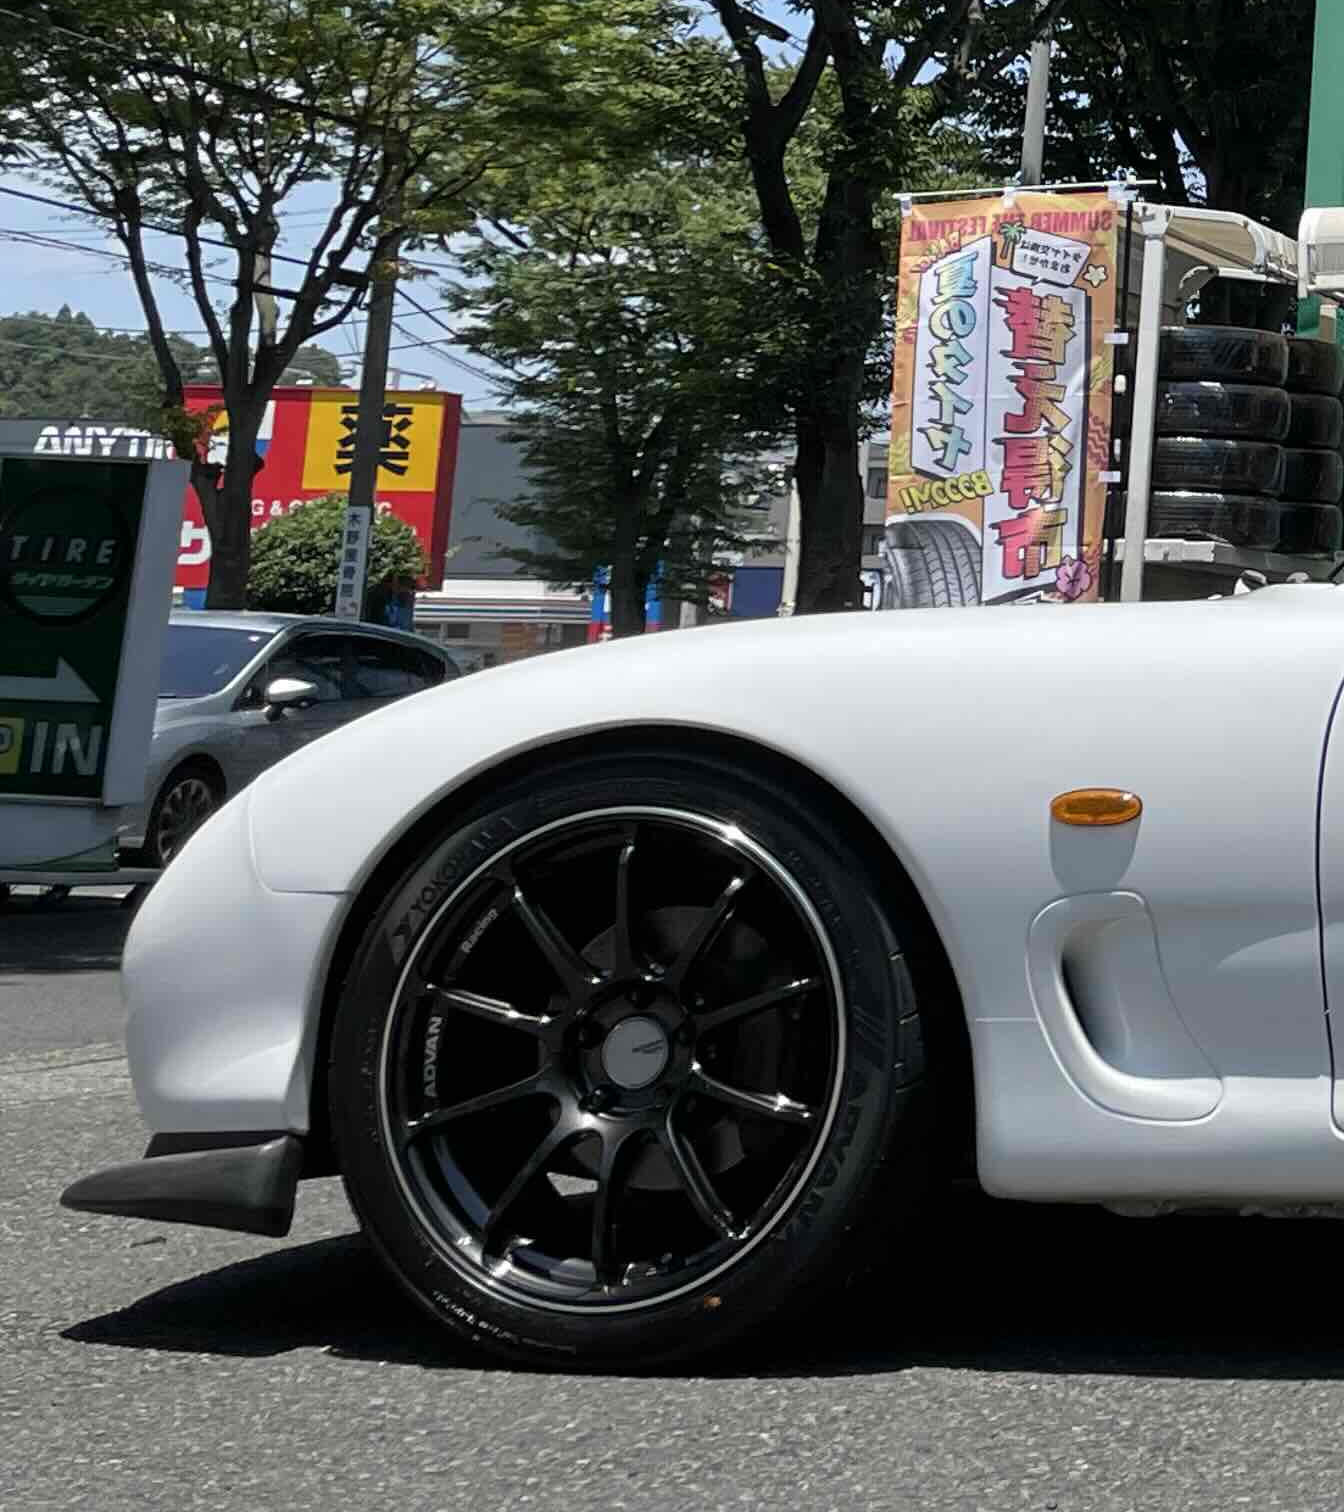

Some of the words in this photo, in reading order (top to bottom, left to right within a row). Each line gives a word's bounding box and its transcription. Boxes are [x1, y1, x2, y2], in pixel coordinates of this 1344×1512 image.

[10, 535, 116, 564] TIRE
[30, 720, 104, 776] IN
[423, 1015, 443, 1097] ADVAN
